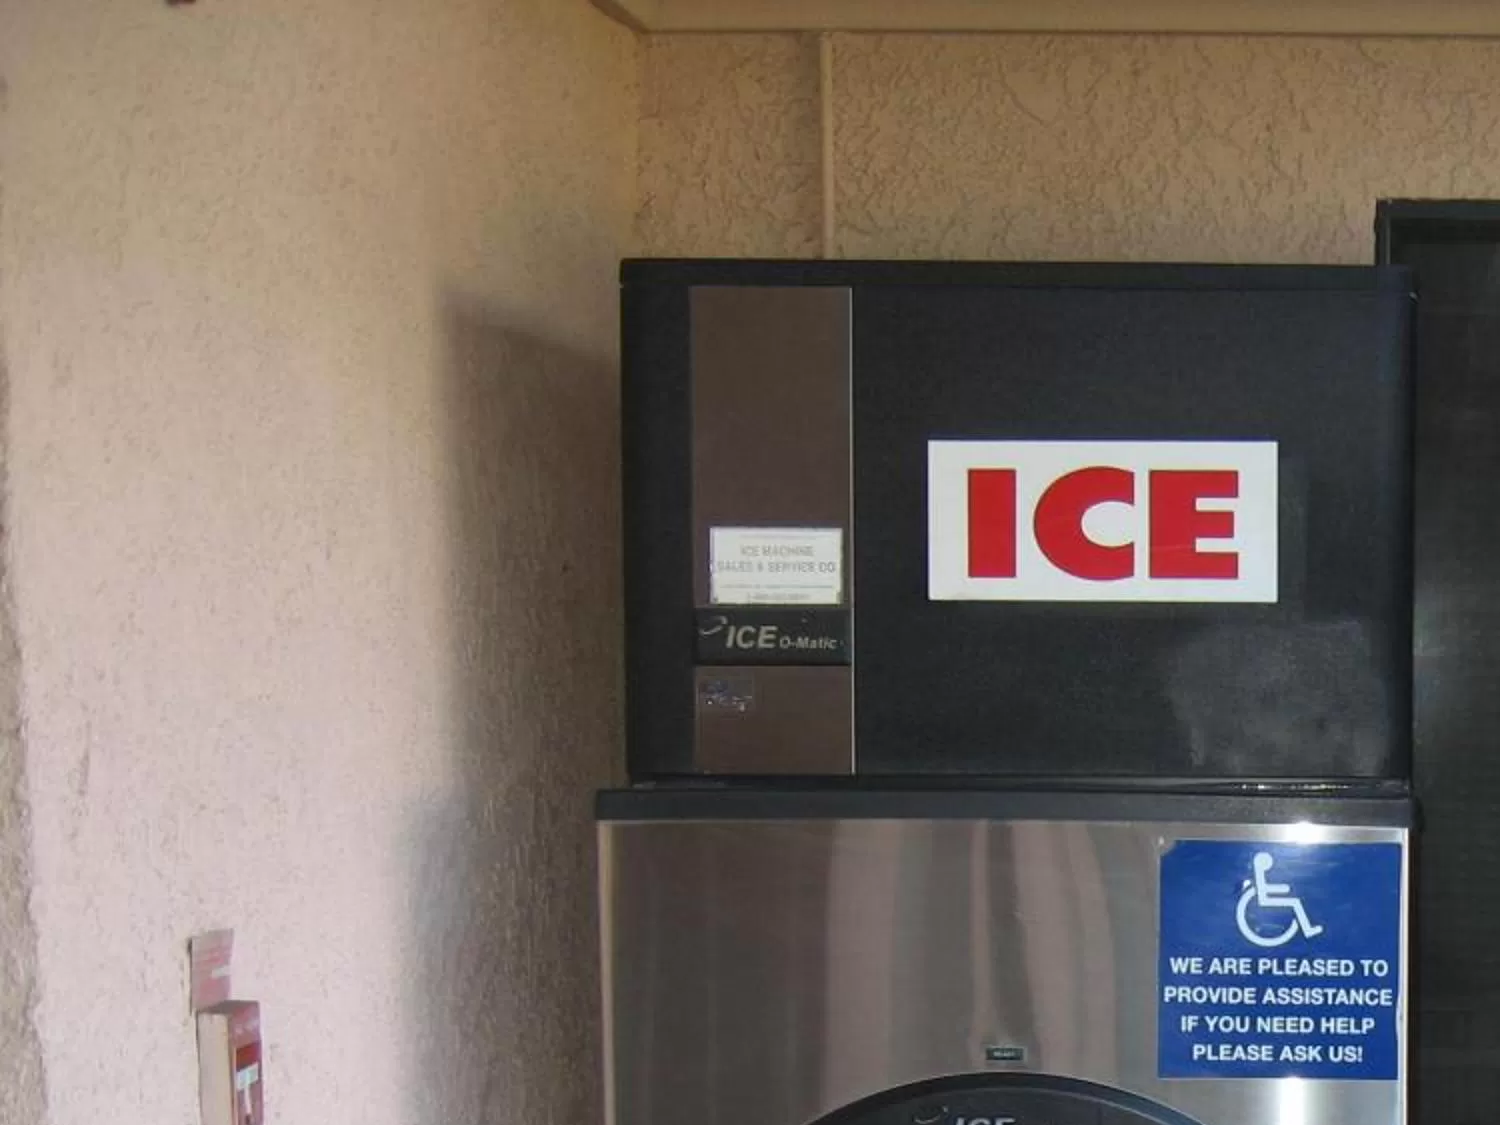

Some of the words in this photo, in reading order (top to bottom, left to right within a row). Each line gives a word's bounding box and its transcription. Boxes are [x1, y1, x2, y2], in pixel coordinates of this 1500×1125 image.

[967, 466, 1239, 581] ICE
[725, 625, 778, 649] ICE
[1170, 957, 1203, 974] WE
[1208, 958, 1252, 975] ARE
[1258, 958, 1354, 976] PLEASED
[1361, 960, 1388, 977] TO
[1164, 986, 1256, 1004] PROVIDE
[1262, 987, 1393, 1006] ASSISTANCE
[1181, 1015, 1199, 1032] IF
[1206, 1016, 1249, 1033] YOU
[1257, 1017, 1314, 1033] NEED
[1321, 1017, 1375, 1034] HELP
[1193, 1044, 1273, 1062] PLEASE
[1279, 1045, 1323, 1062] ASK
[1329, 1046, 1363, 1063] US!
